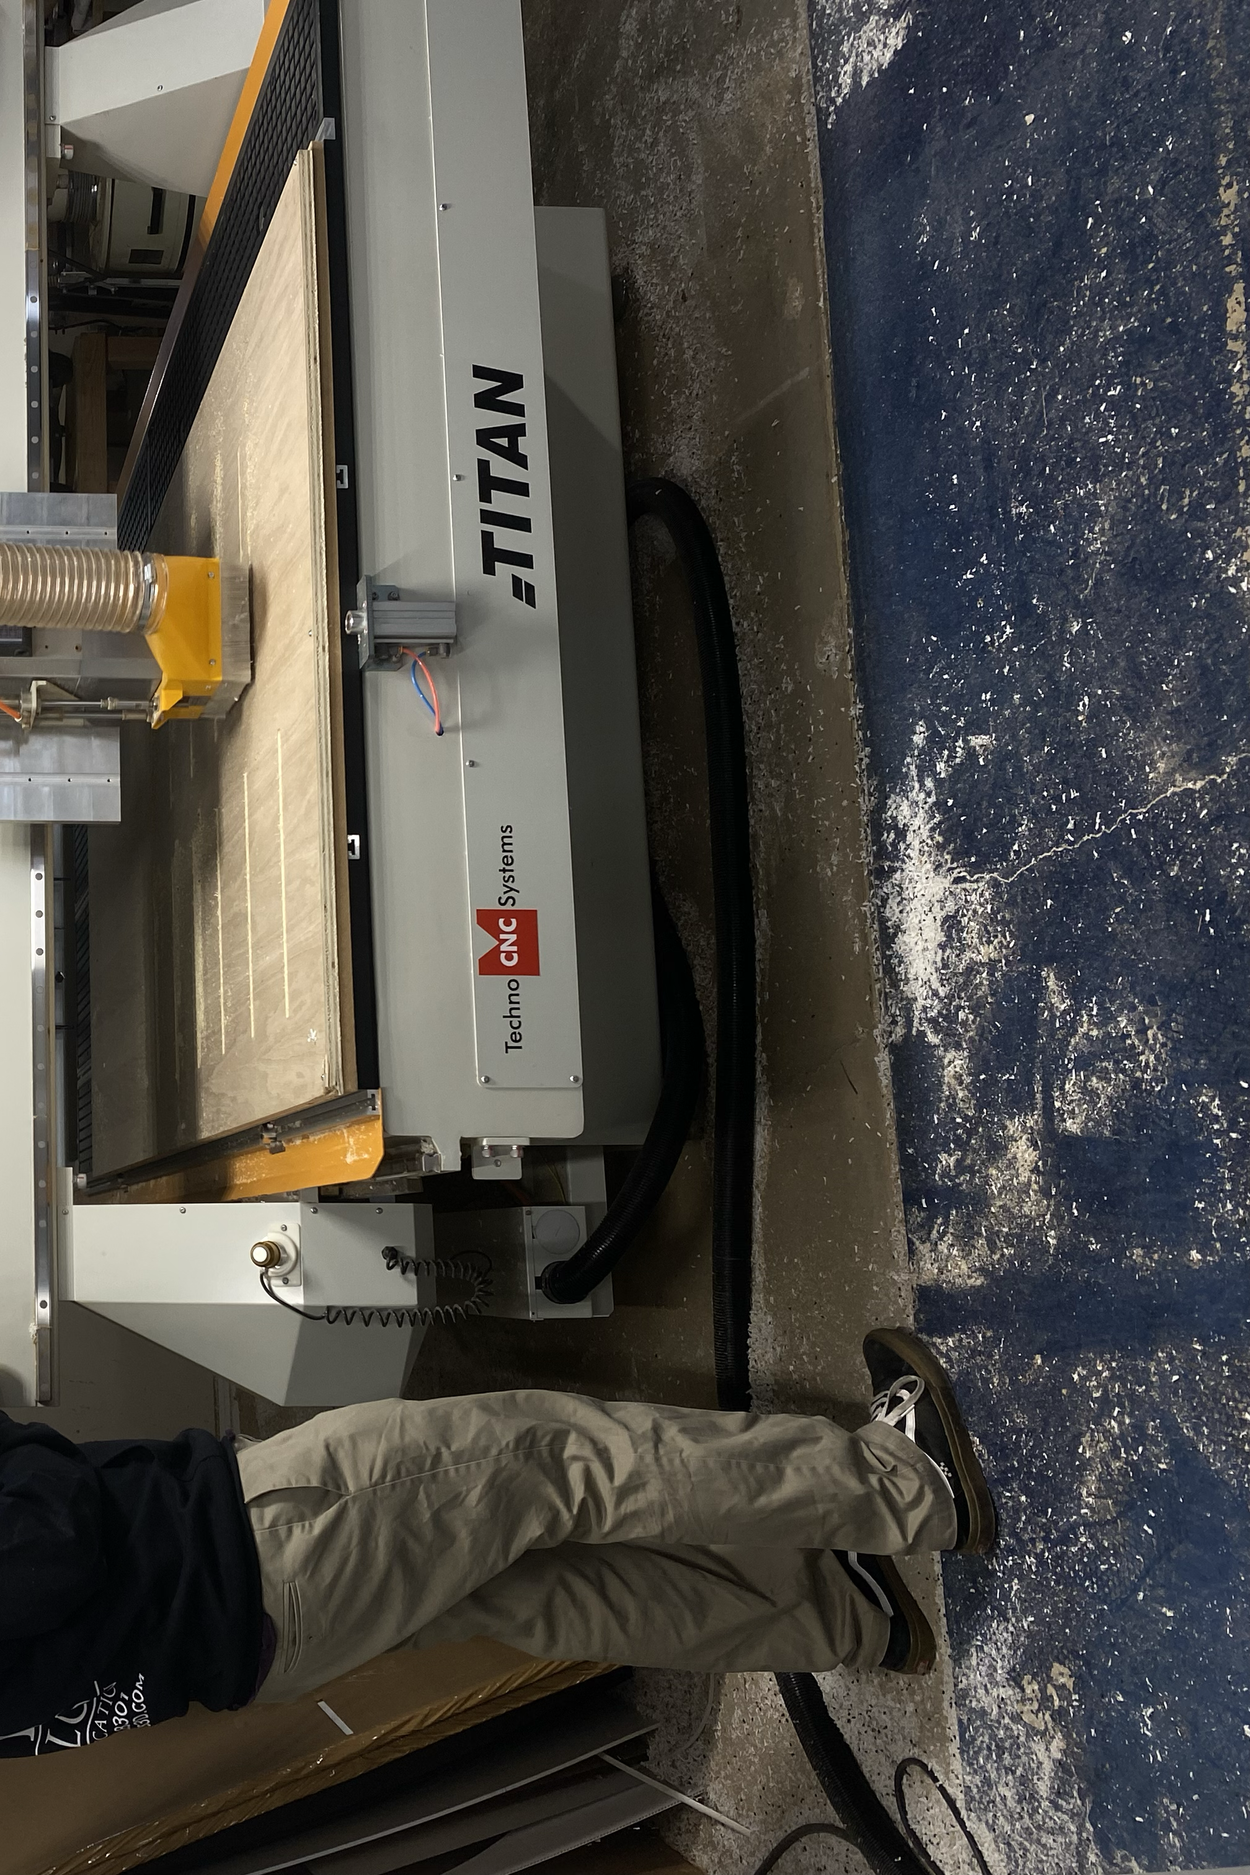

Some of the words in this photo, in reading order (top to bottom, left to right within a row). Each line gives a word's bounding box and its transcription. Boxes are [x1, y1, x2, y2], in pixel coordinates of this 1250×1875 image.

[472, 364, 534, 576] TITAN
[498, 824, 520, 908] Systems
[498, 918, 518, 967] CNC
[502, 978, 522, 1054] Techno
